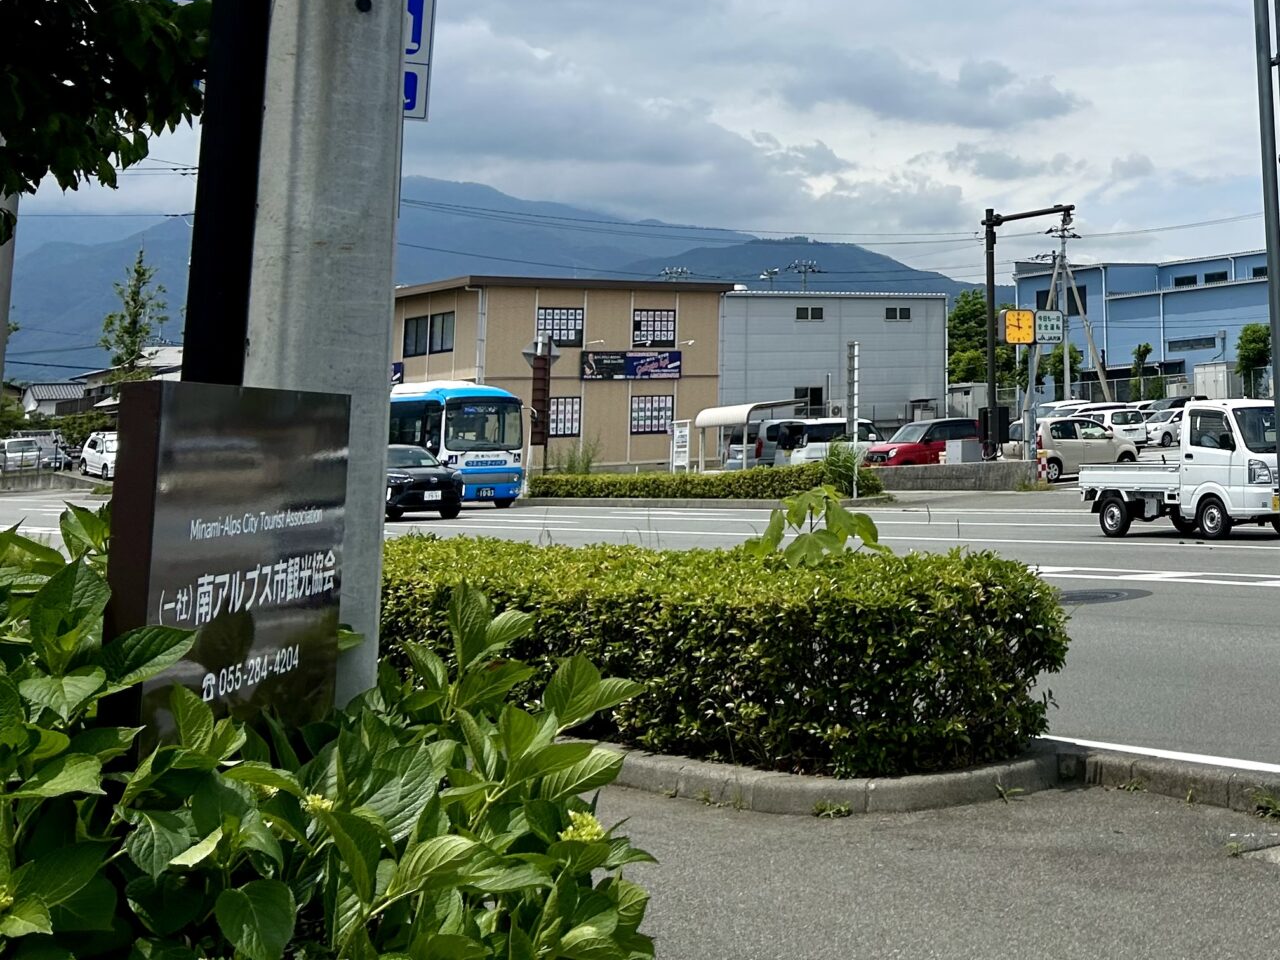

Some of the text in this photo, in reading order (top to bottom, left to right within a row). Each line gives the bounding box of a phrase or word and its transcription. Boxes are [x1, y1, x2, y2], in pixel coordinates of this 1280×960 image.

[190, 508, 323, 540] Minami-Alps City Tourist Association
[219, 643, 300, 697] 055-284-4204
